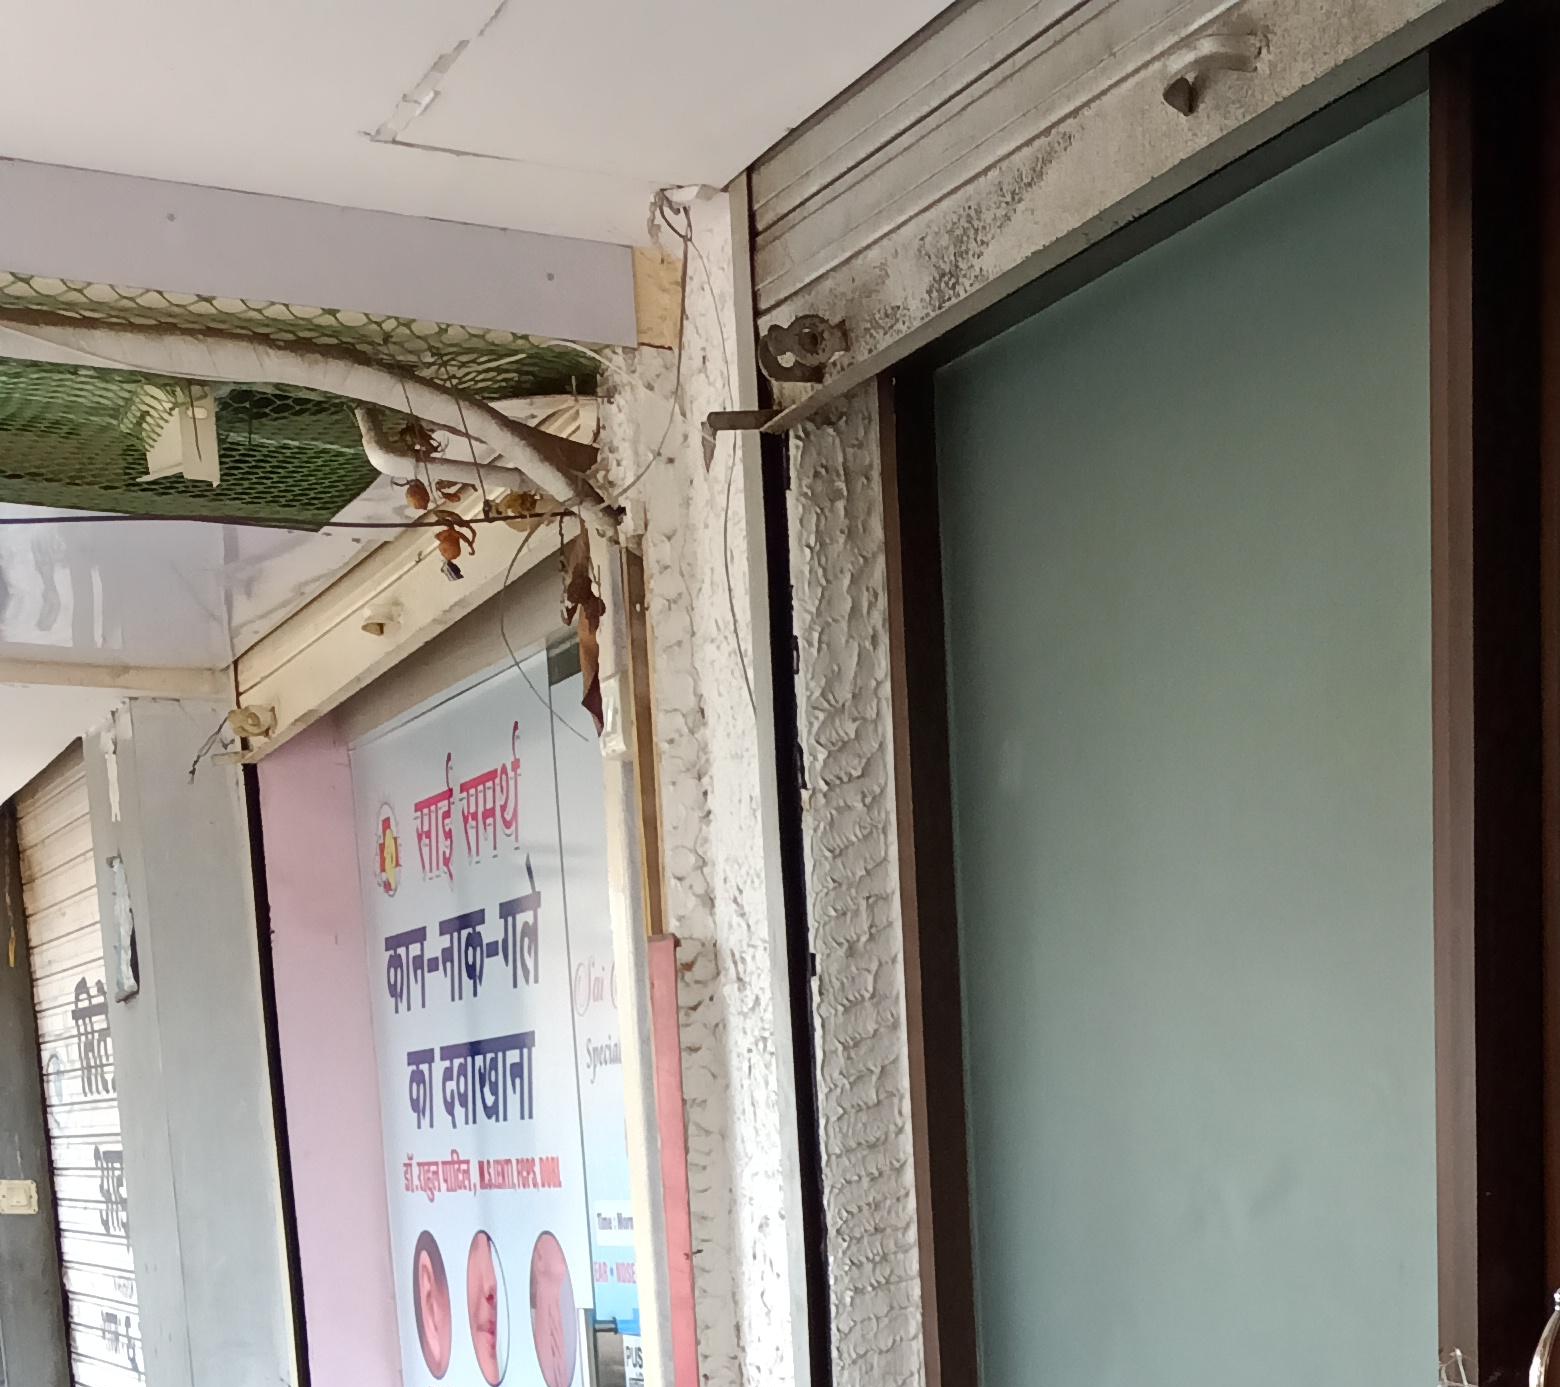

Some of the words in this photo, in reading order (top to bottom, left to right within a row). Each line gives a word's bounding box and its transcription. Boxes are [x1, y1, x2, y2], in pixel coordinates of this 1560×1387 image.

[459, 721, 520, 858] समर्थ
[407, 1047, 435, 1130] का
[440, 1030, 536, 1129] दवाखाना
